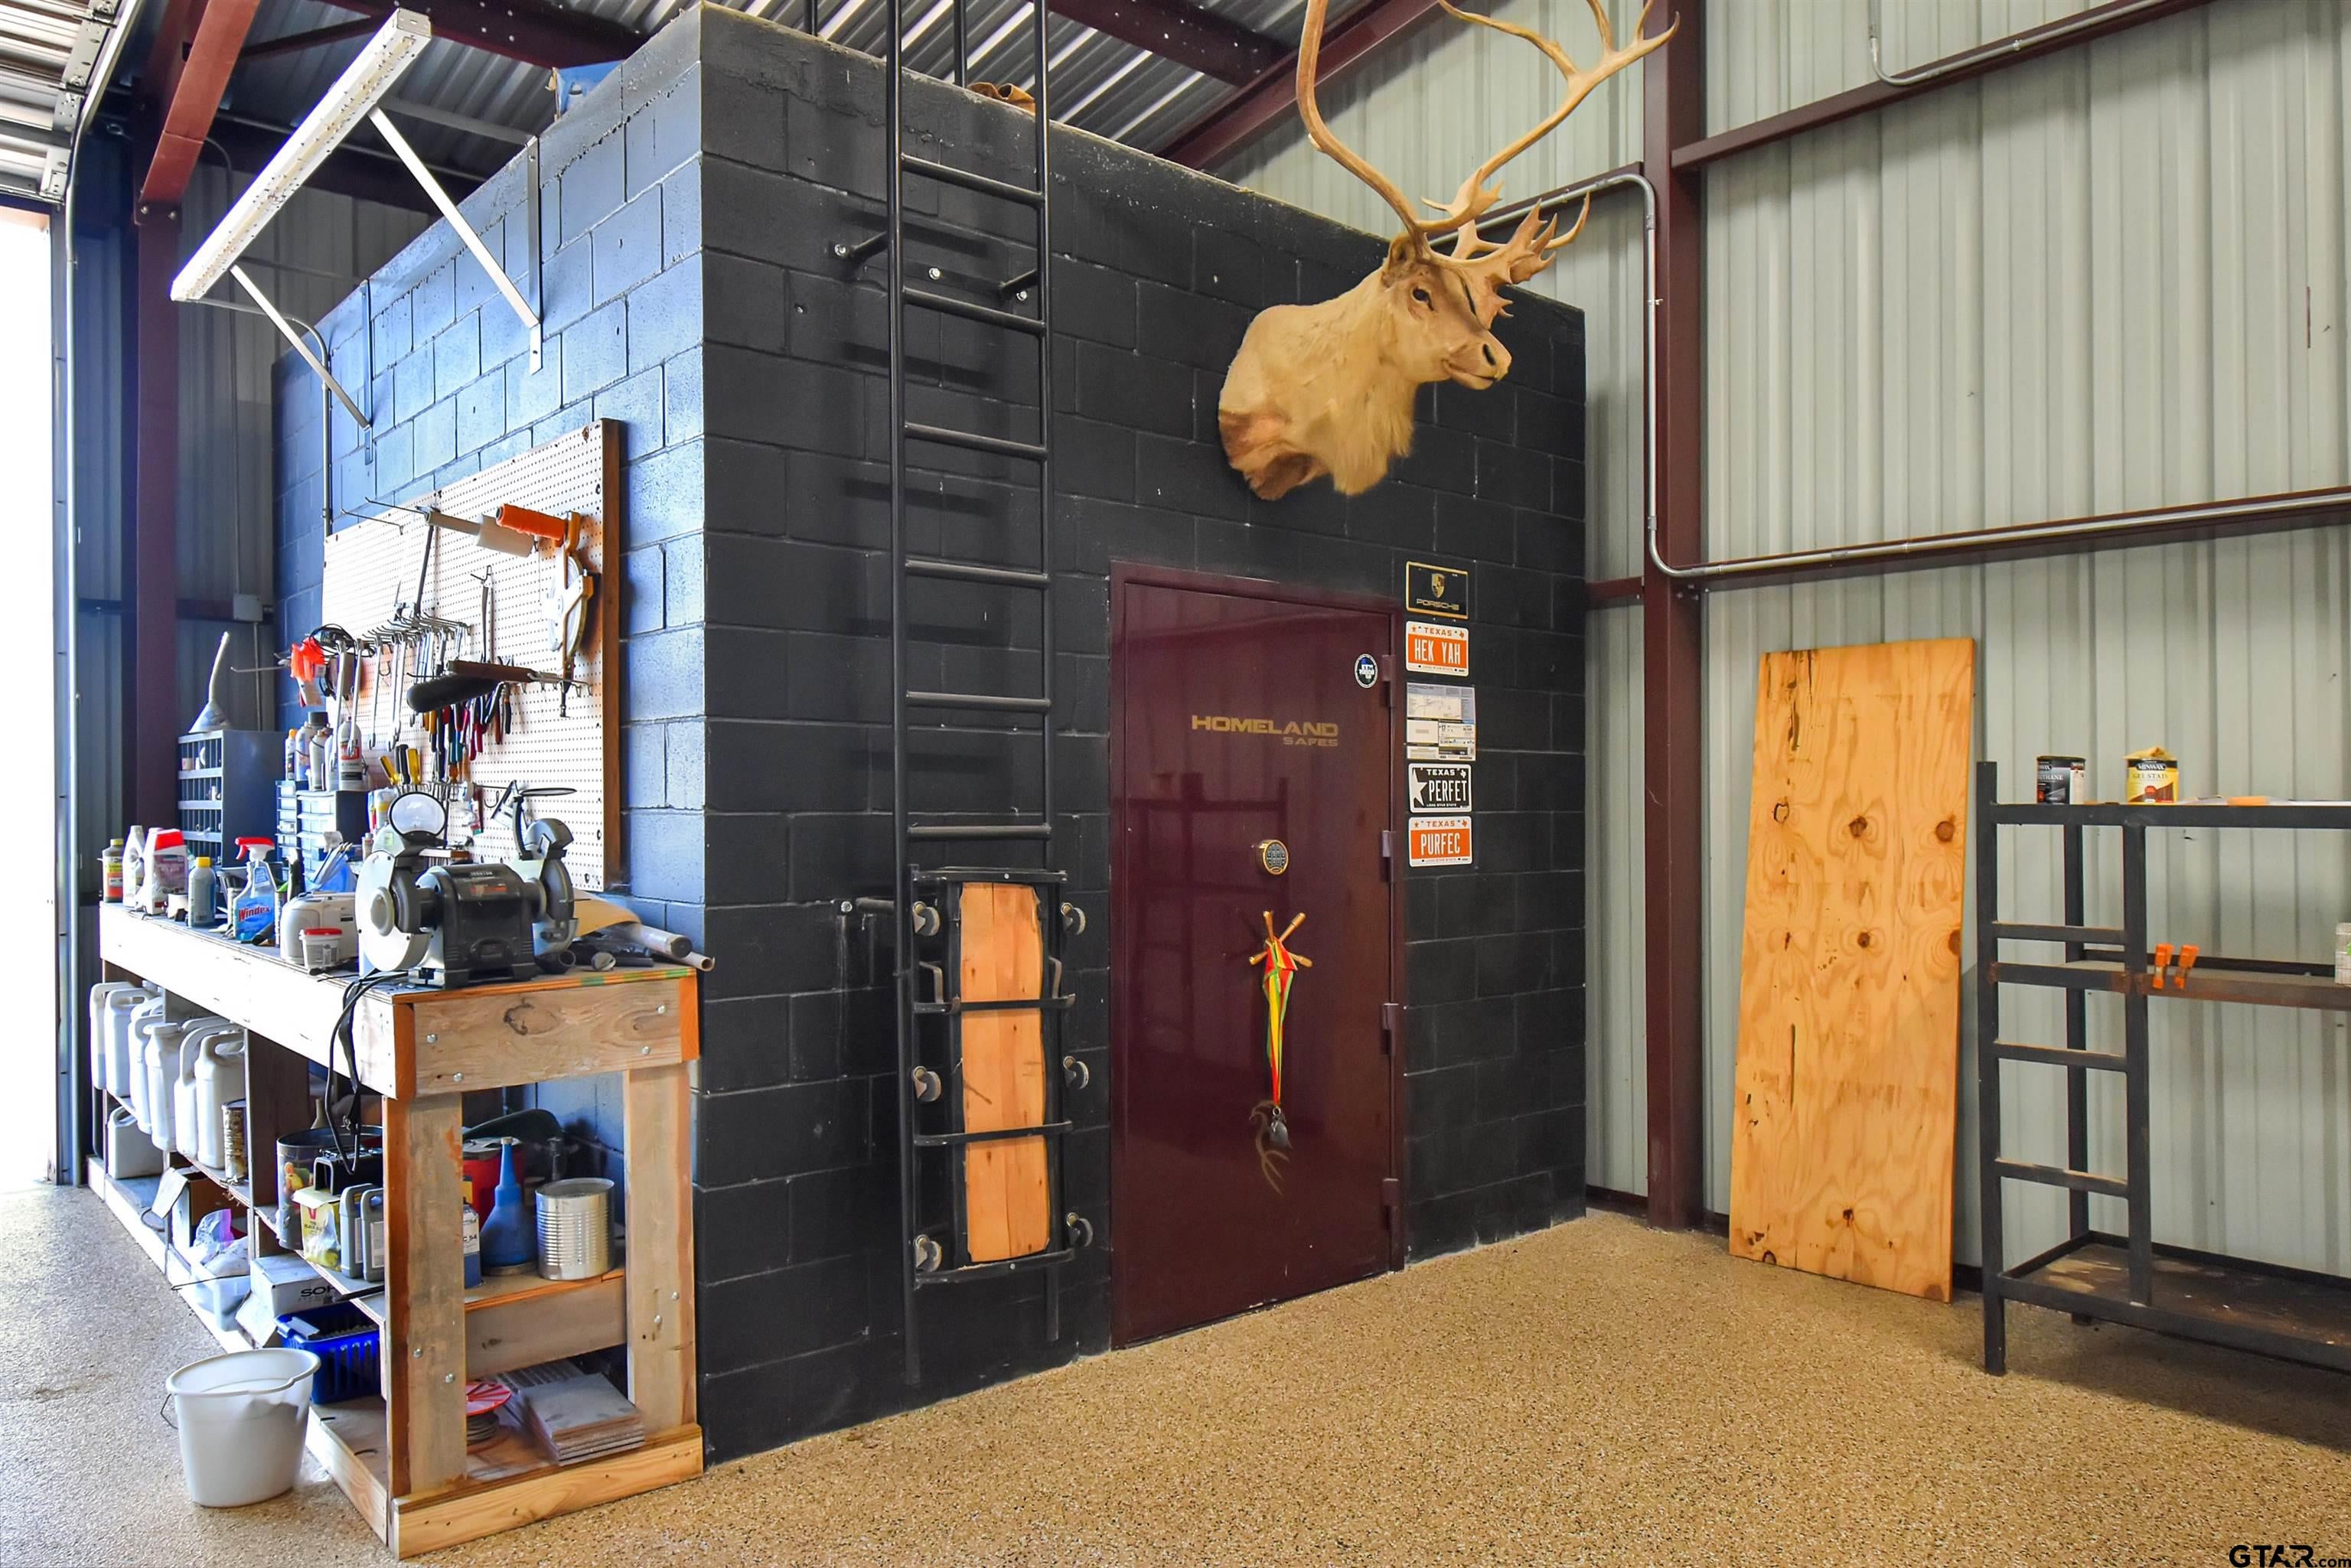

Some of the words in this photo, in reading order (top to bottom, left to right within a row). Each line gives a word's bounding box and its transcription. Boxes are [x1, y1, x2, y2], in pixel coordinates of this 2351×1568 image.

[1417, 598, 1459, 611] PORSCHE
[1424, 627, 1452, 636] TEXAS
[1414, 638, 1434, 662] HEK
[1441, 641, 1460, 665] YAH
[1192, 715, 1339, 737] HOMELAND
[1283, 736, 1339, 747] SAFES
[1429, 780, 1467, 801] PERFET
[1420, 833, 1461, 856] PURFEC
[238, 906, 270, 923] Windex
